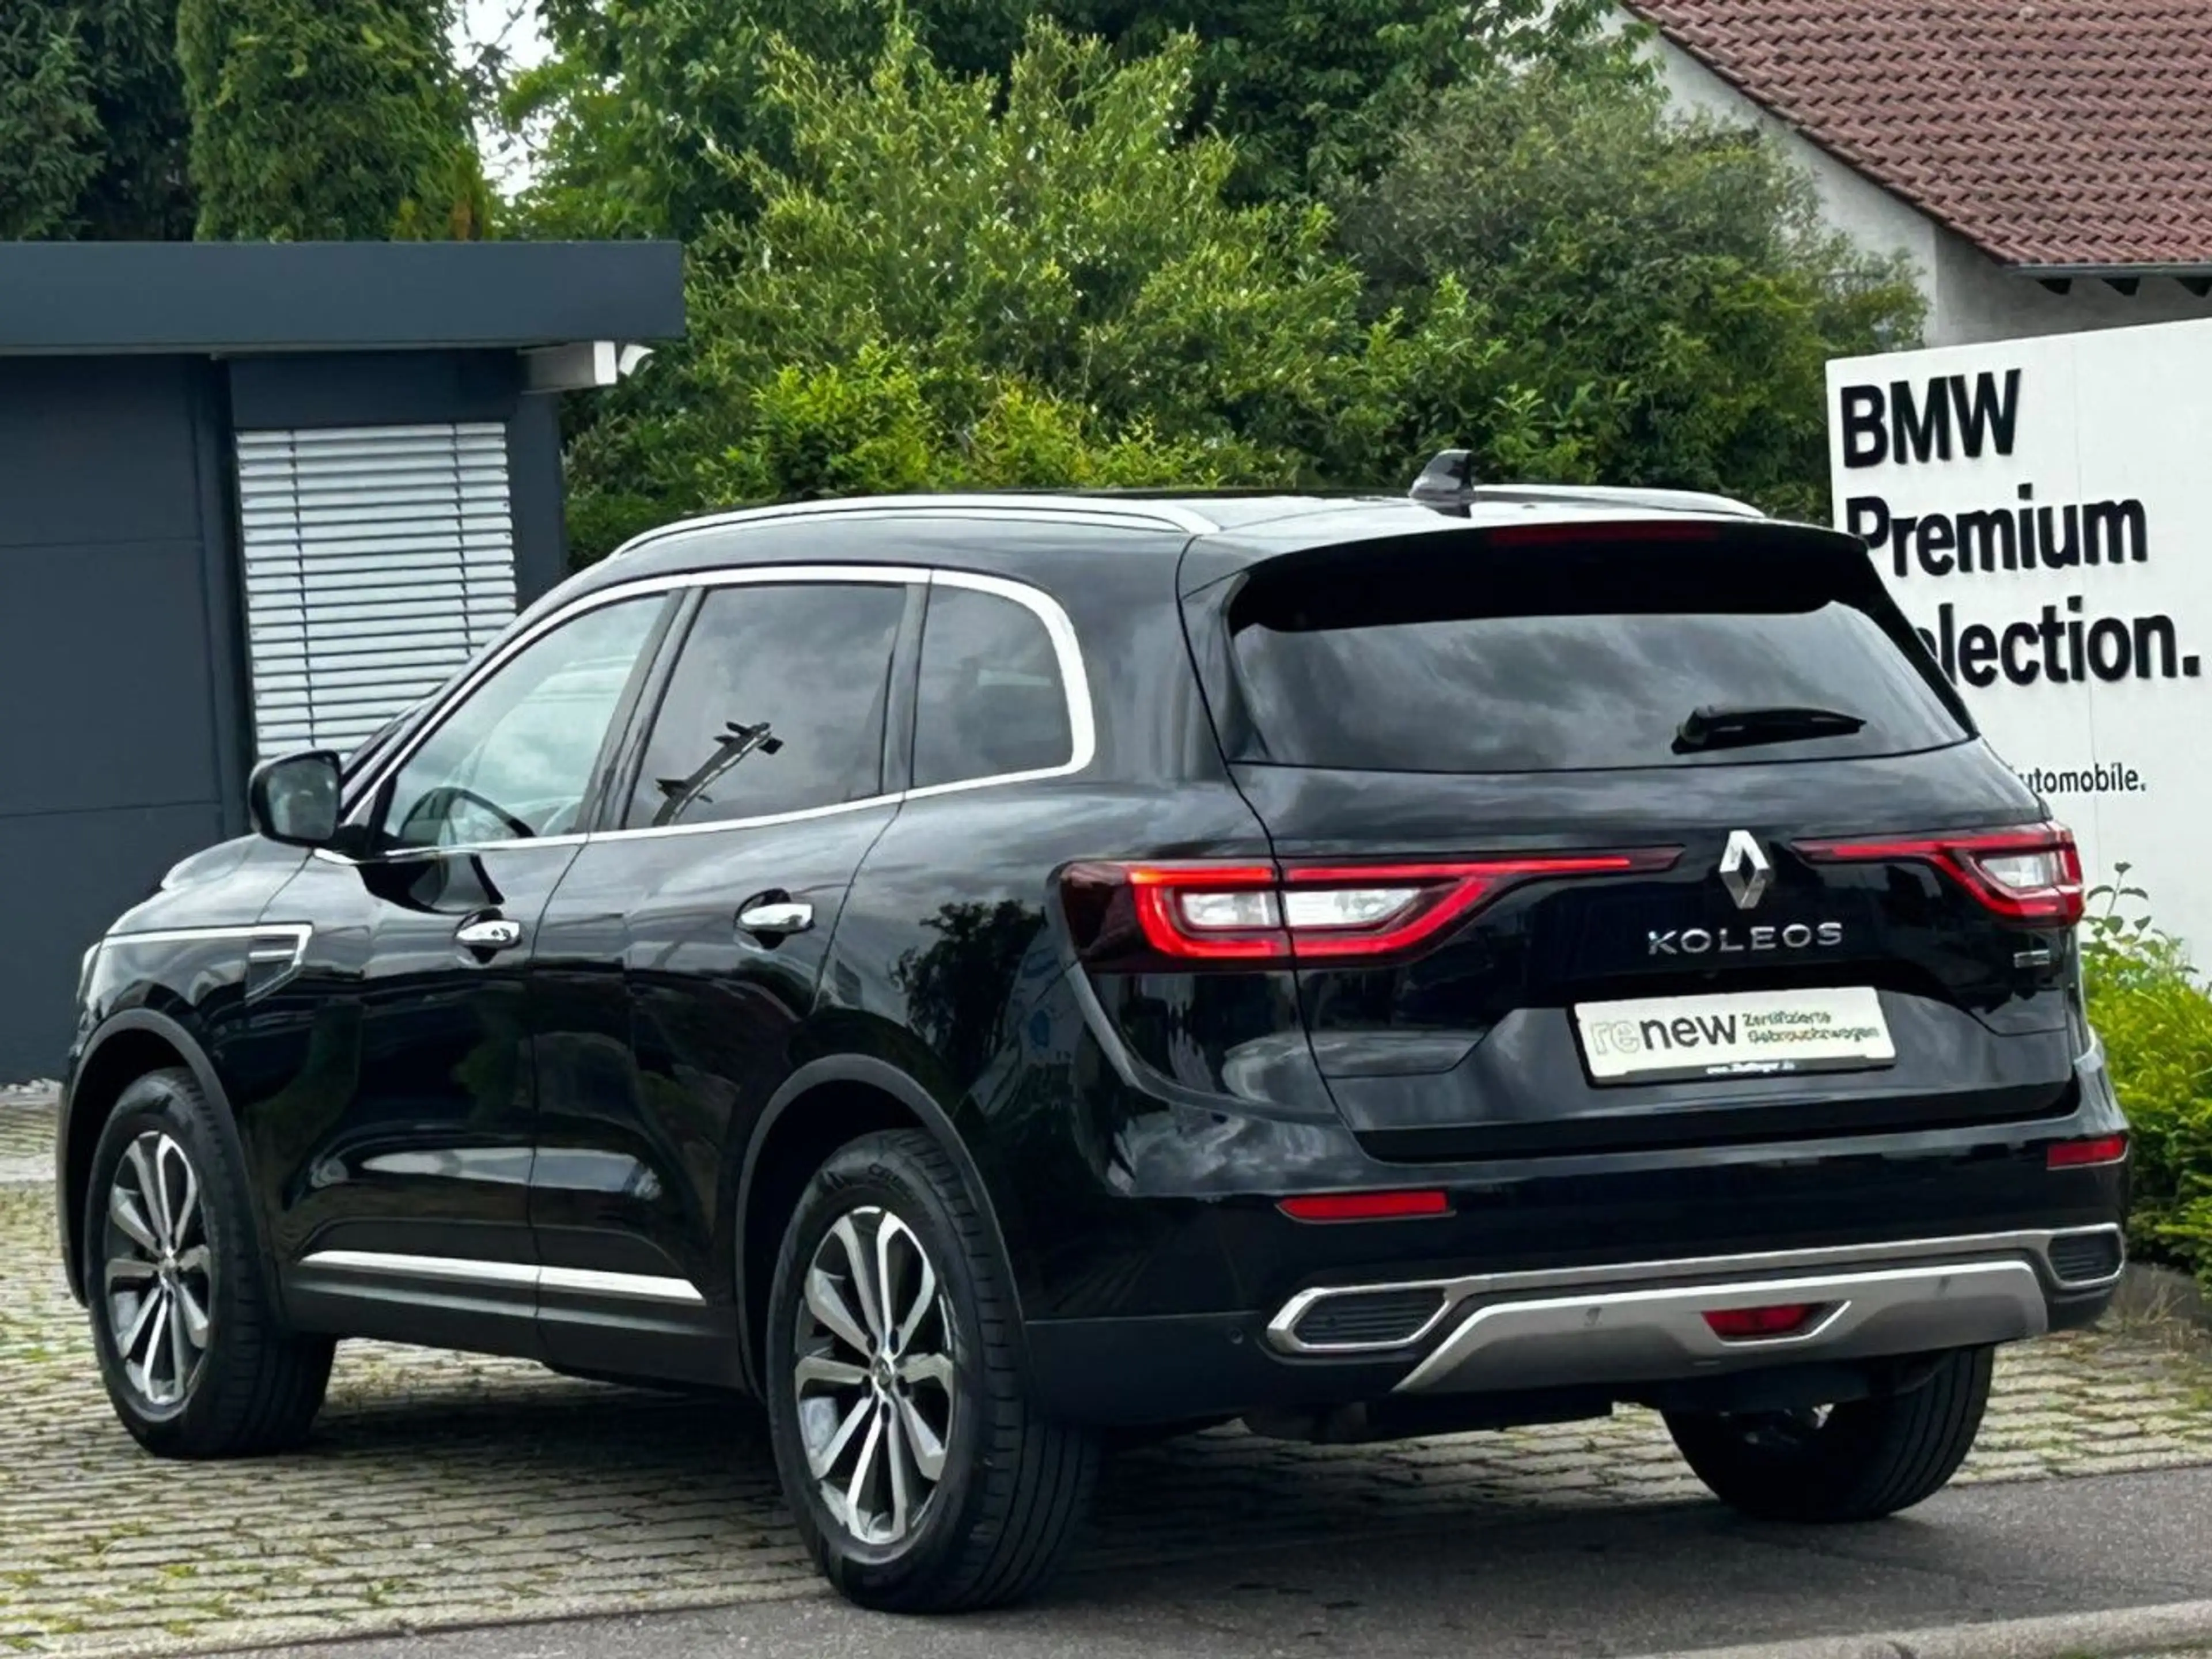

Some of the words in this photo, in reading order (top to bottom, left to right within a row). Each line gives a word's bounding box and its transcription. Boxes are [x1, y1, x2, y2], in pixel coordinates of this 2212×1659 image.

[1841, 369, 2021, 468] BMW
[1846, 483, 2147, 577] Premium
[1648, 922, 1842, 955] KOLEOS
[1590, 1014, 1736, 1055] renew
